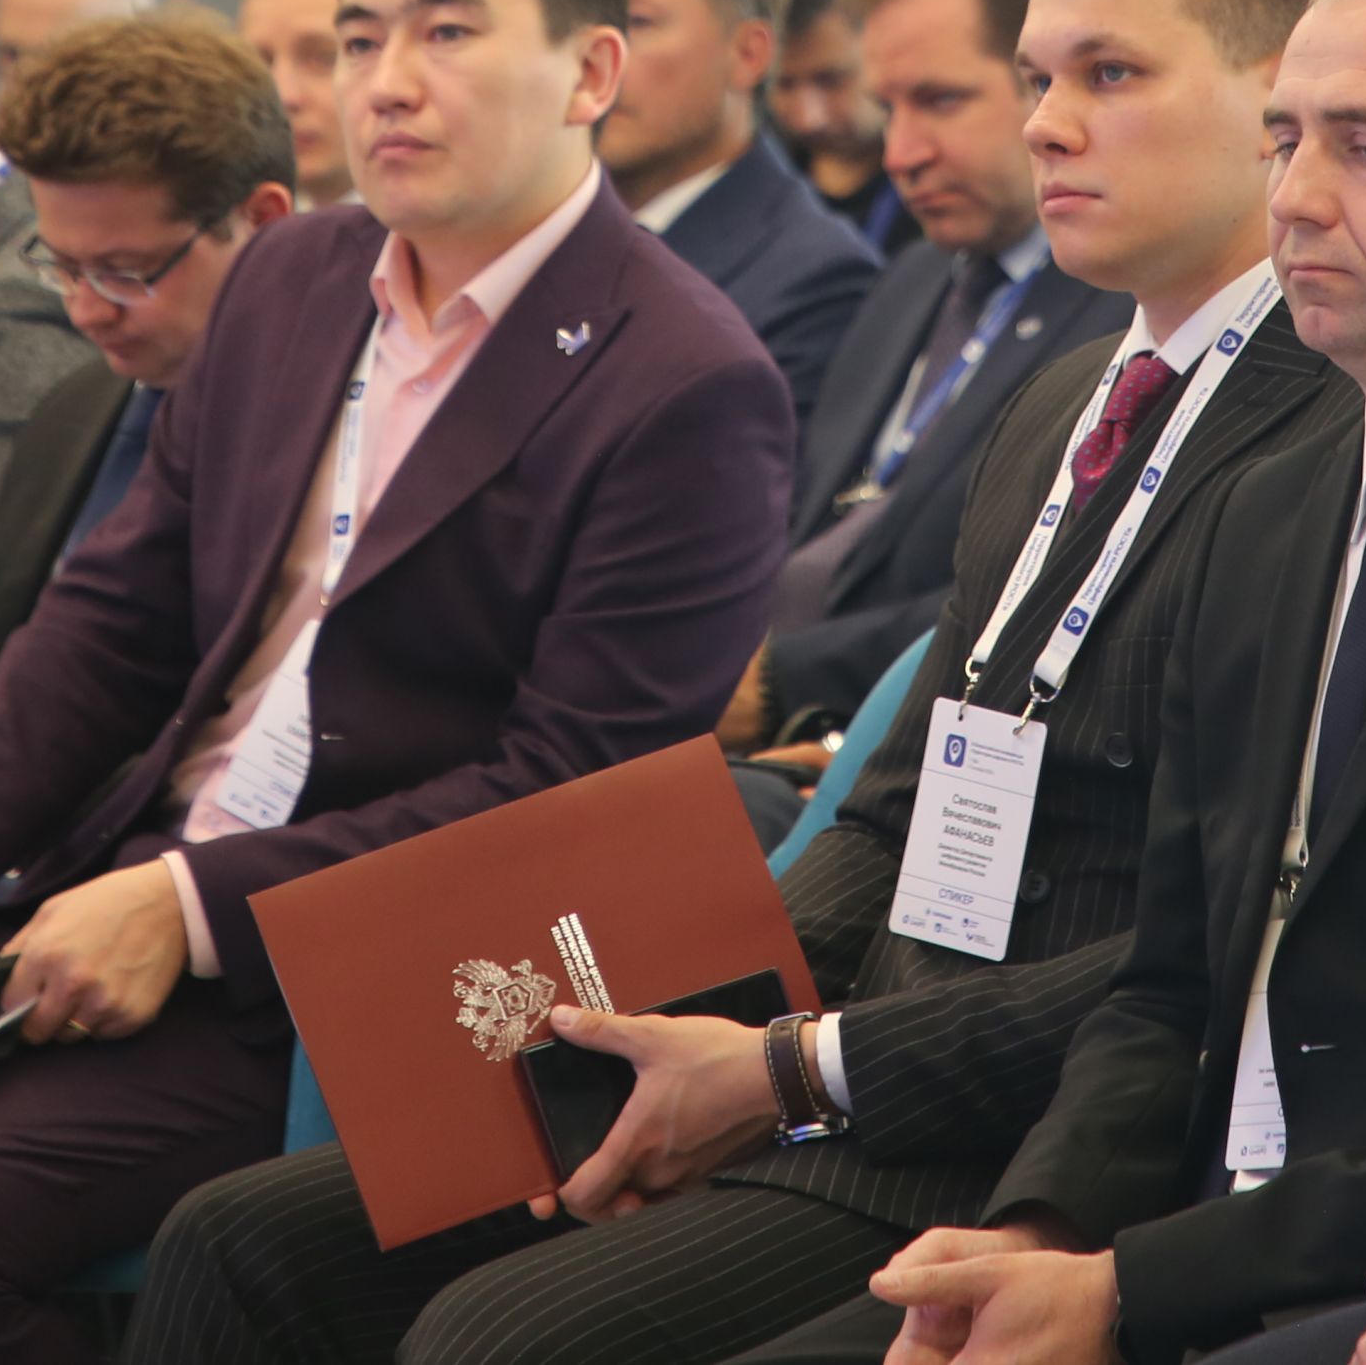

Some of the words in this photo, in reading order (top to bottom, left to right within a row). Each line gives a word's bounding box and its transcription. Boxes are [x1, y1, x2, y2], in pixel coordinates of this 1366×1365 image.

[952, 793, 997, 815] Святослав
[942, 806, 1001, 830] Вячеславович
[943, 824, 994, 847] АФАНАСЬЕВ
[938, 888, 975, 905] СПИКЕР
[551, 926, 570, 958] НАУКИ
[568, 912, 595, 966] ФЕДЕРАЦИИ
